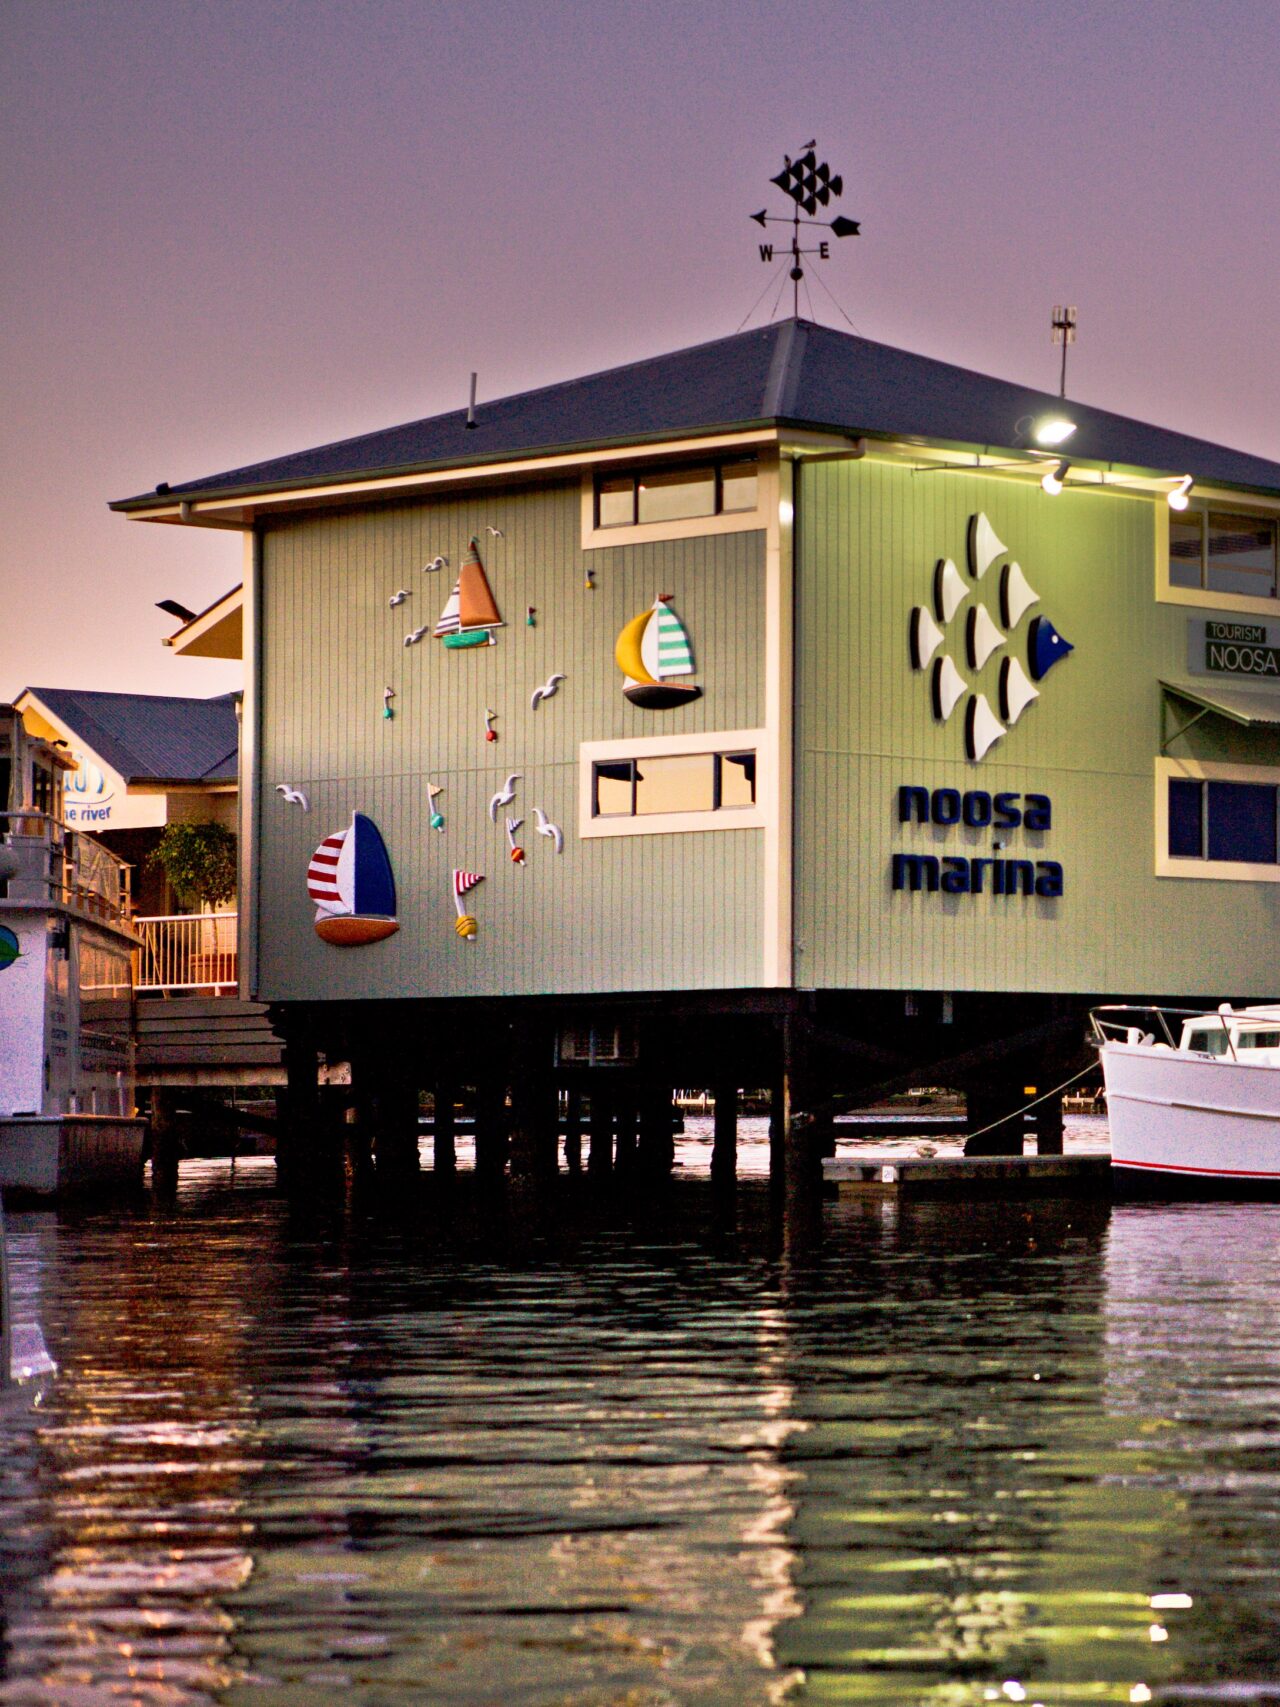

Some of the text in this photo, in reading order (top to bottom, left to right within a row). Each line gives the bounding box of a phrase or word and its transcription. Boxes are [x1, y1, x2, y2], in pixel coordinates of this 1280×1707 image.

[759, 241, 829, 262] W E
[1210, 623, 1262, 641] TOURISM
[1210, 645, 1279, 674] NOOSA
[81, 805, 112, 821] river
[898, 785, 1052, 831] noosa
[892, 842, 1063, 896] marina
